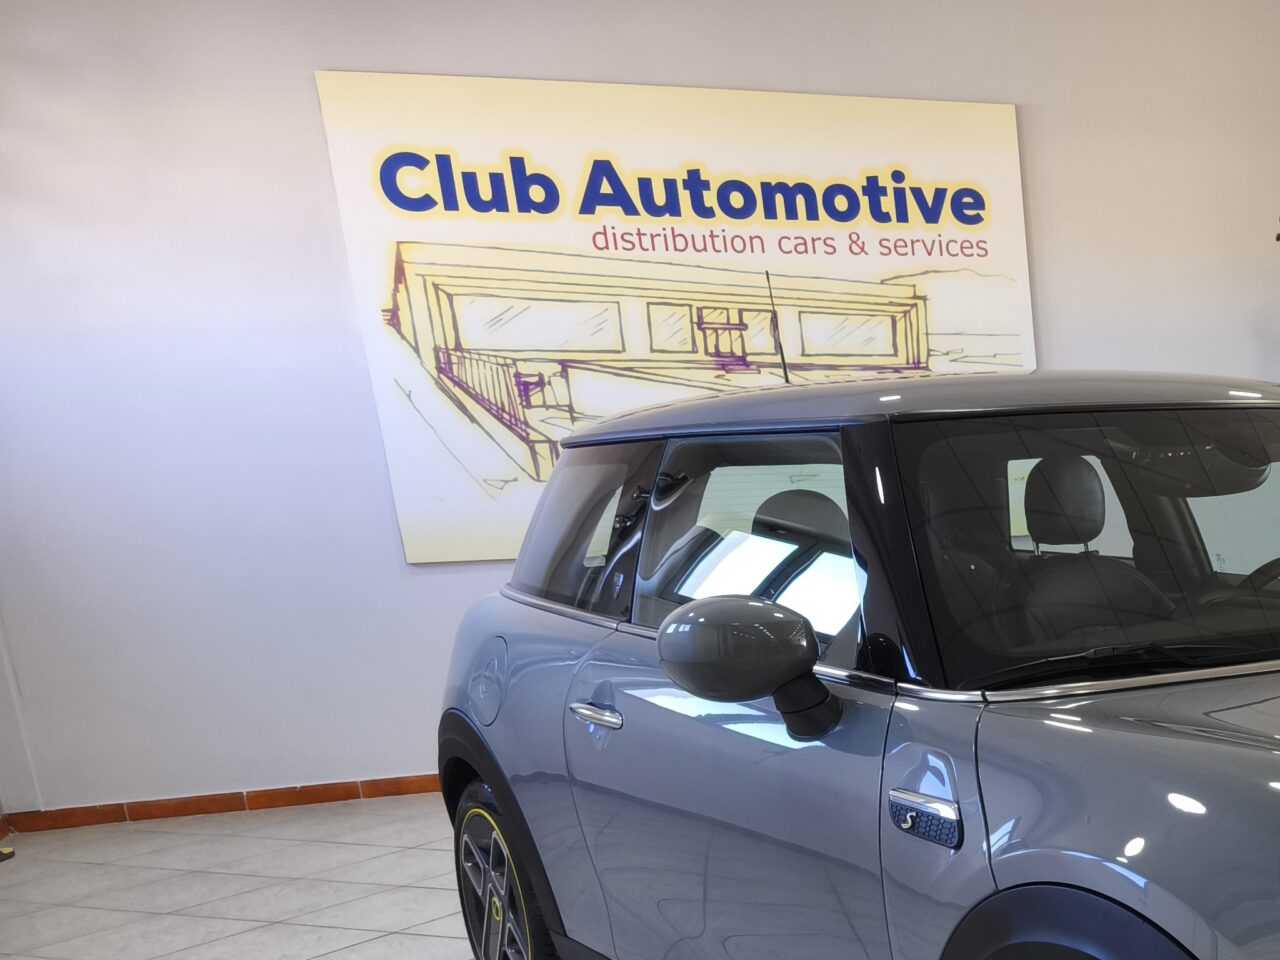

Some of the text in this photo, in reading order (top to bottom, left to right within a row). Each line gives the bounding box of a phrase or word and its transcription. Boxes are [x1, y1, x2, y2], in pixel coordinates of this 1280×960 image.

[379, 151, 986, 226] Club Automotive
[592, 224, 989, 258] distribution cars & services
